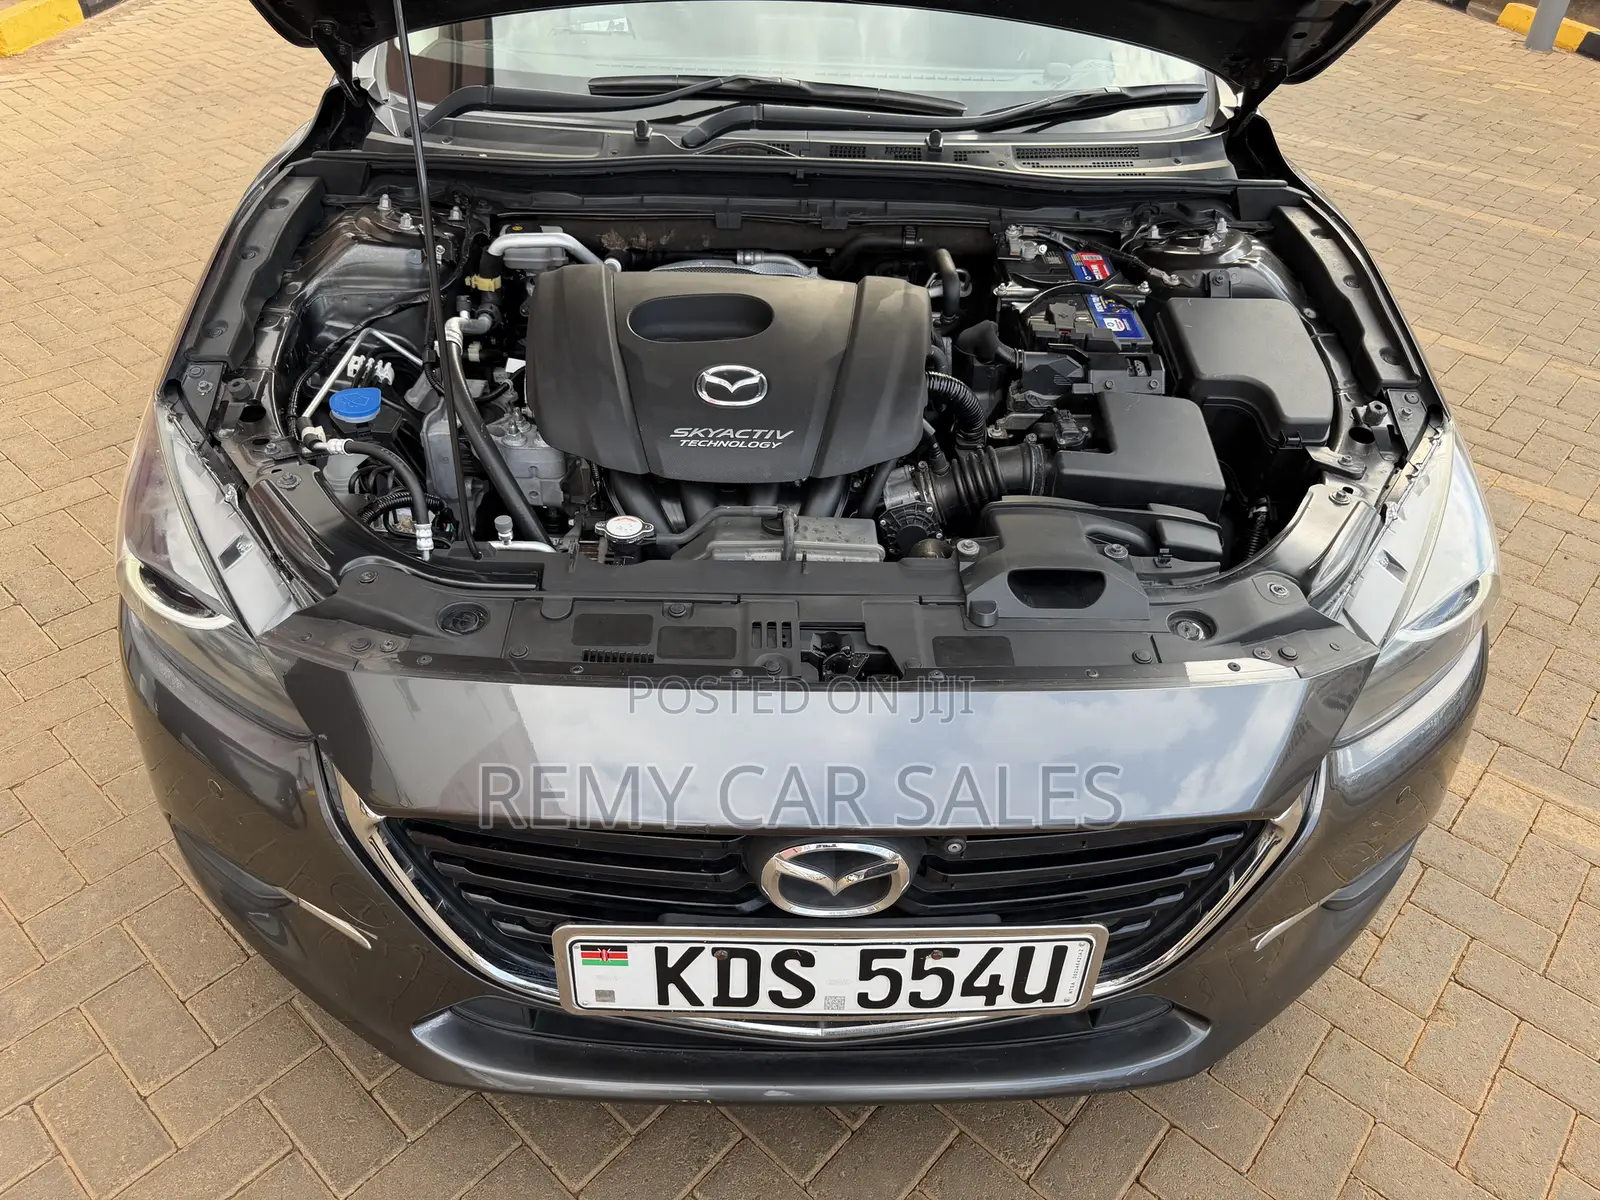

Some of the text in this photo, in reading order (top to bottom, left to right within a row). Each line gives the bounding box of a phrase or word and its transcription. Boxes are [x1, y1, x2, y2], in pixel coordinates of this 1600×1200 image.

[669, 428, 794, 439] SKYACTIV
[679, 439, 783, 449] TECHNOLOGY
[654, 944, 1068, 1009] KDS 554U
